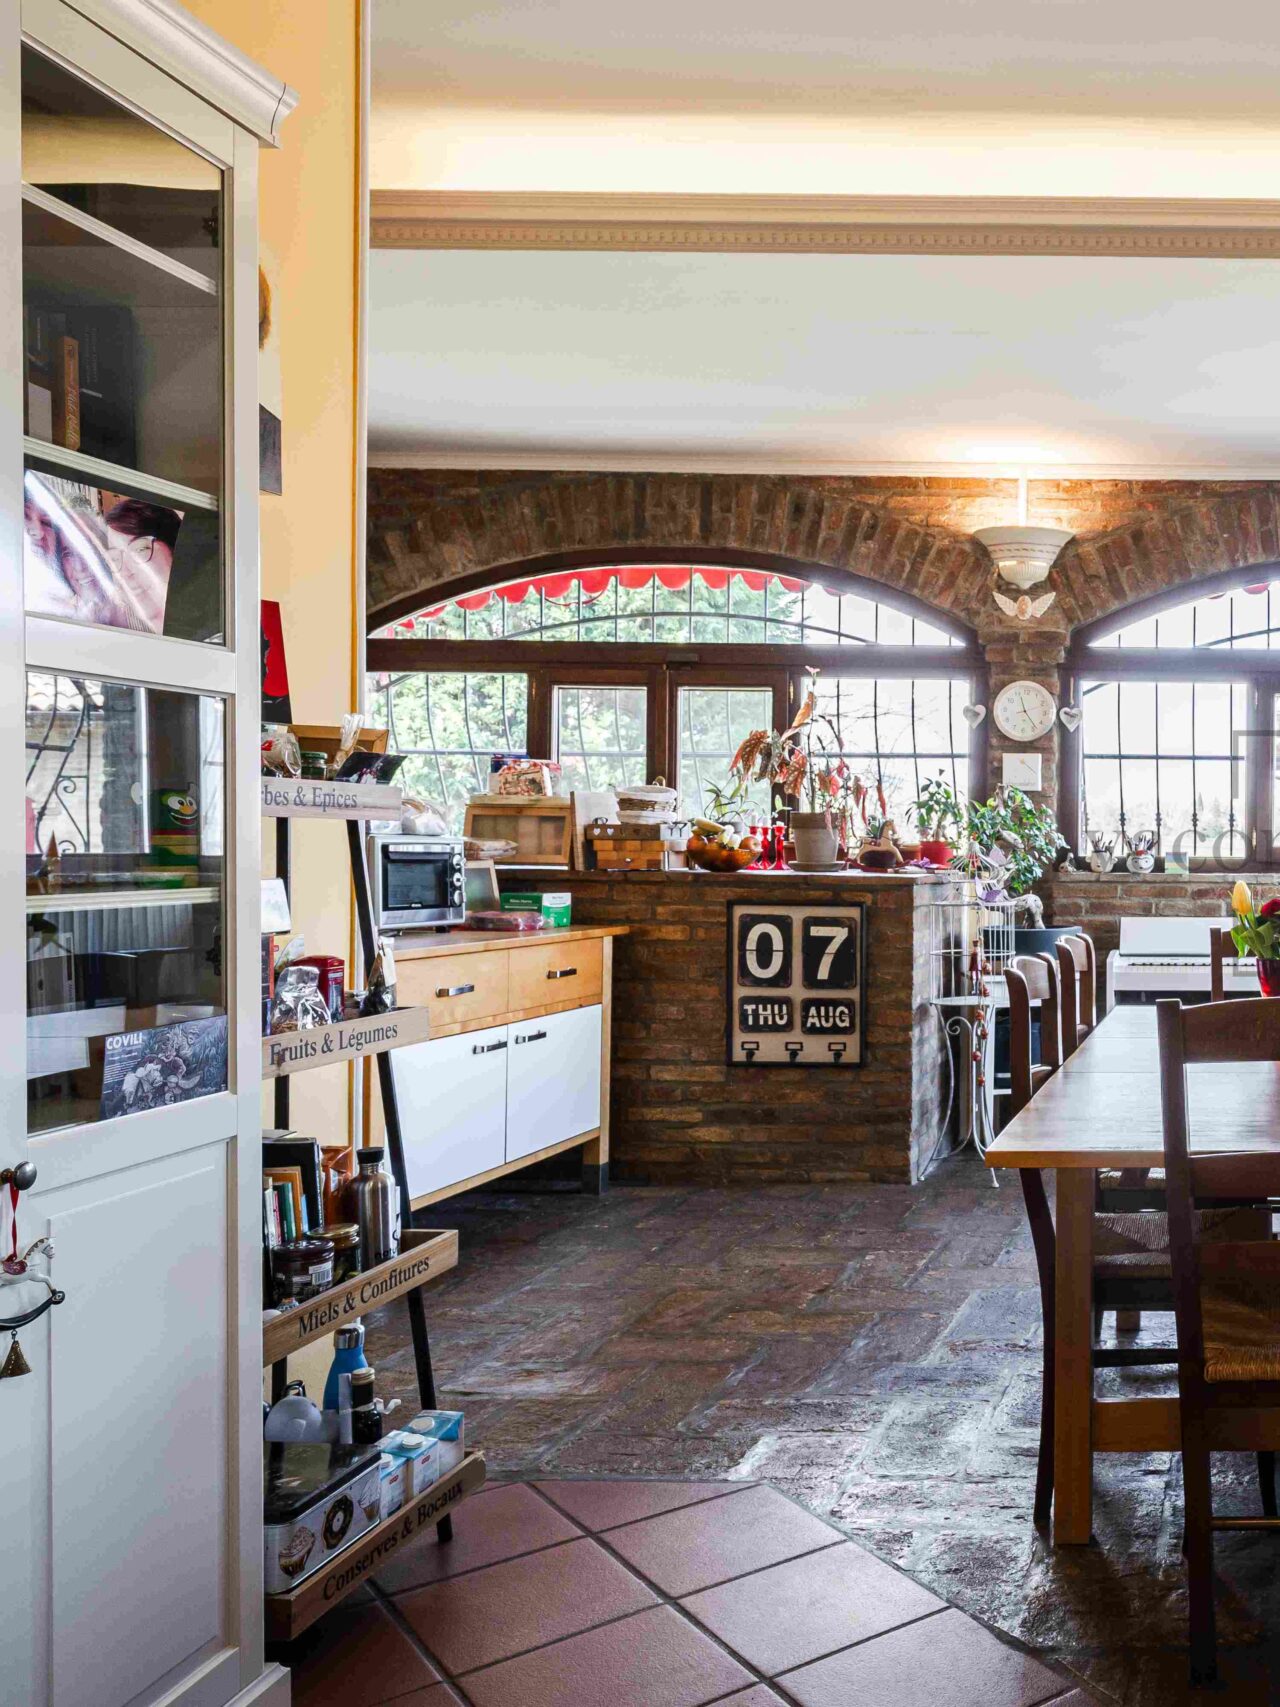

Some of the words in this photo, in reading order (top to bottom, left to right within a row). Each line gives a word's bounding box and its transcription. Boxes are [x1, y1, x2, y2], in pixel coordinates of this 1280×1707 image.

[261, 784, 290, 806] bes
[293, 785, 307, 807] &
[311, 786, 358, 812] Epices
[743, 1003, 788, 1026] THU
[806, 1005, 850, 1028] AUG
[106, 1032, 142, 1050] COVILI
[270, 1042, 317, 1066] Fruits
[321, 1032, 333, 1055] &
[338, 1023, 398, 1052] Légumes
[298, 1301, 340, 1339] Miels
[343, 1291, 357, 1314] &
[360, 1256, 430, 1304] Confitures
[323, 1530, 399, 1601] Conserves
[401, 1514, 414, 1540] &
[416, 1481, 463, 1526] Bocaux
